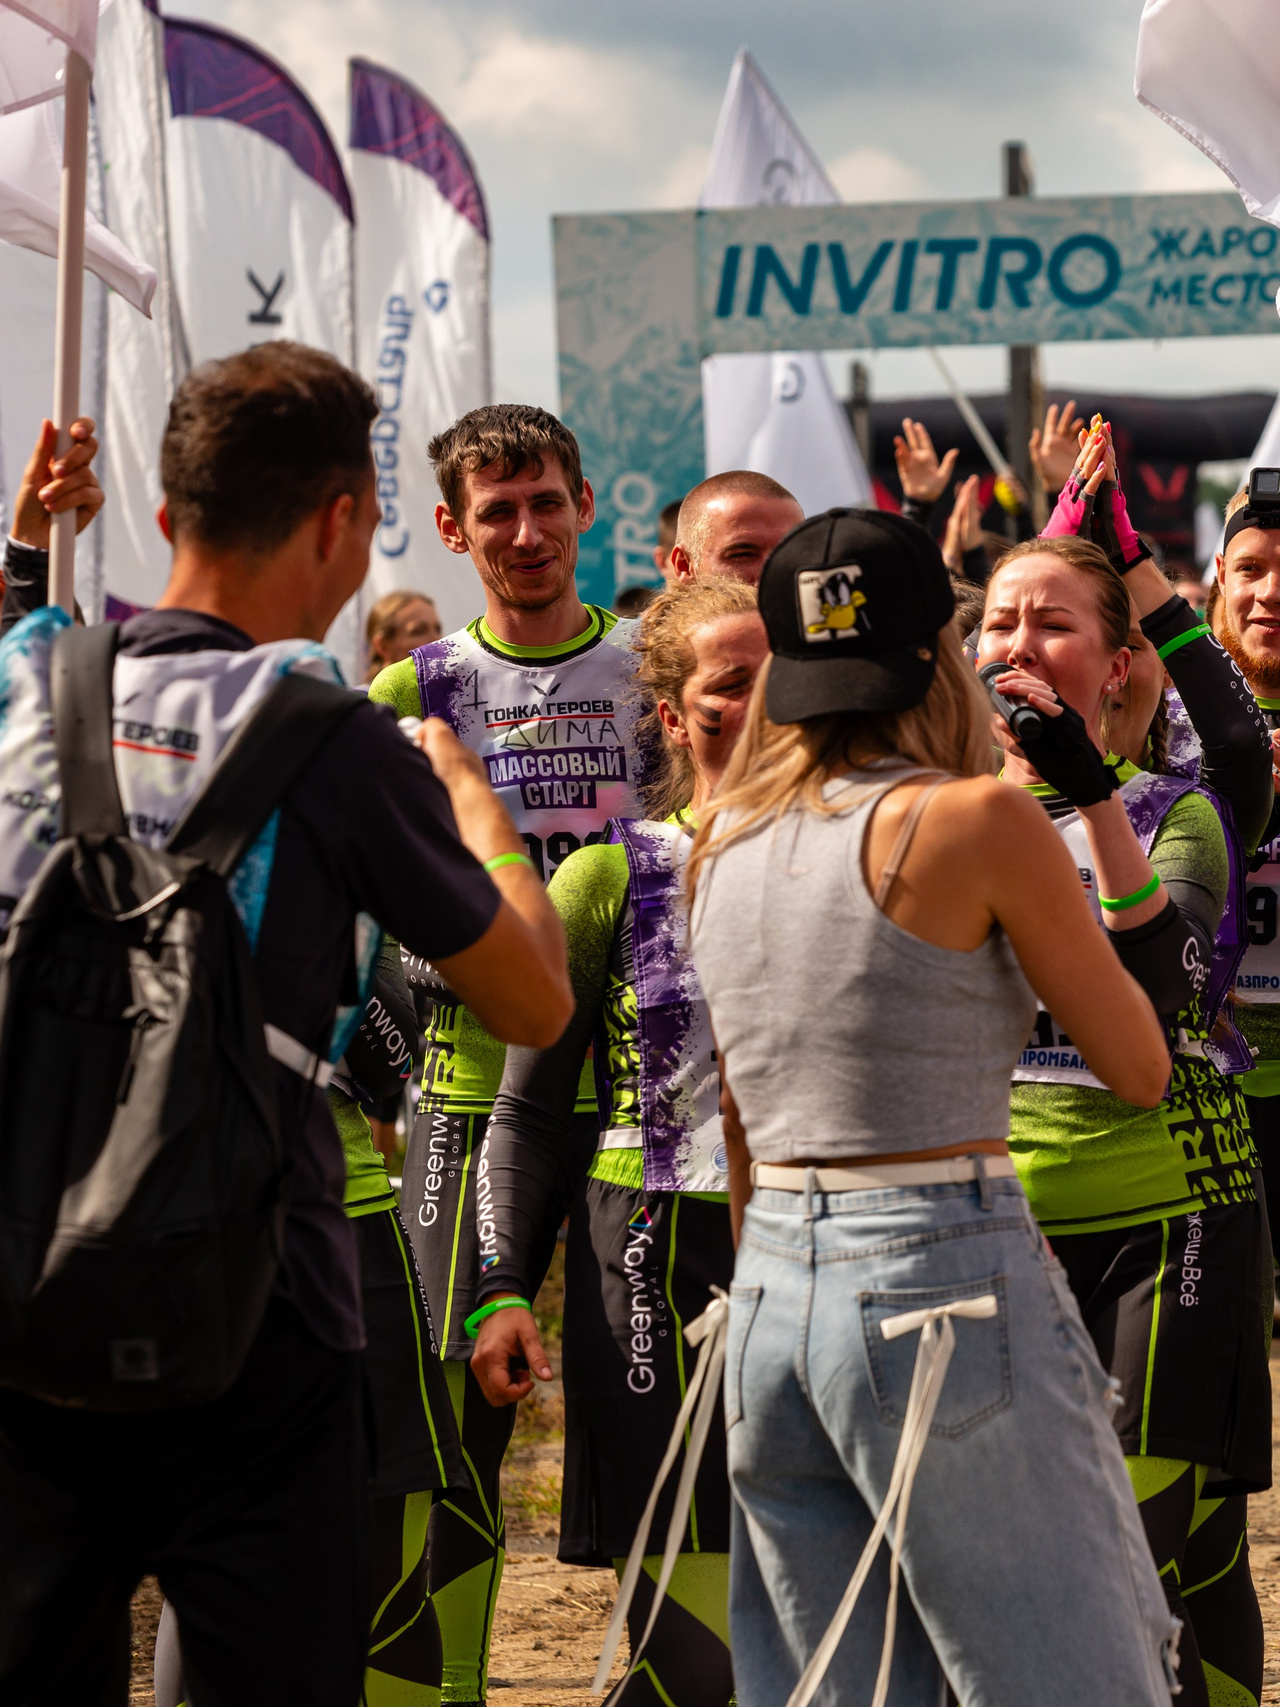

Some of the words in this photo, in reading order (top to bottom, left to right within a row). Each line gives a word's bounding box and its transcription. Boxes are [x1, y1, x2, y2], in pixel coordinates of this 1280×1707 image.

[715, 233, 1121, 318] INVITRO
[484, 704, 542, 723] ГОНКА
[546, 700, 615, 716] ГЕРОЕВ
[500, 719, 621, 752] ДИМА
[489, 745, 622, 784] МАССОВЫЙ
[525, 781, 592, 806] СТАРТ
[359, 1024, 378, 1050] BAL
[365, 996, 411, 1067] nway
[418, 1112, 449, 1227] Greenw
[447, 1118, 462, 1179] GLOBA
[627, 1226, 658, 1395] Greenway
[652, 1264, 668, 1338] GLOBAL
